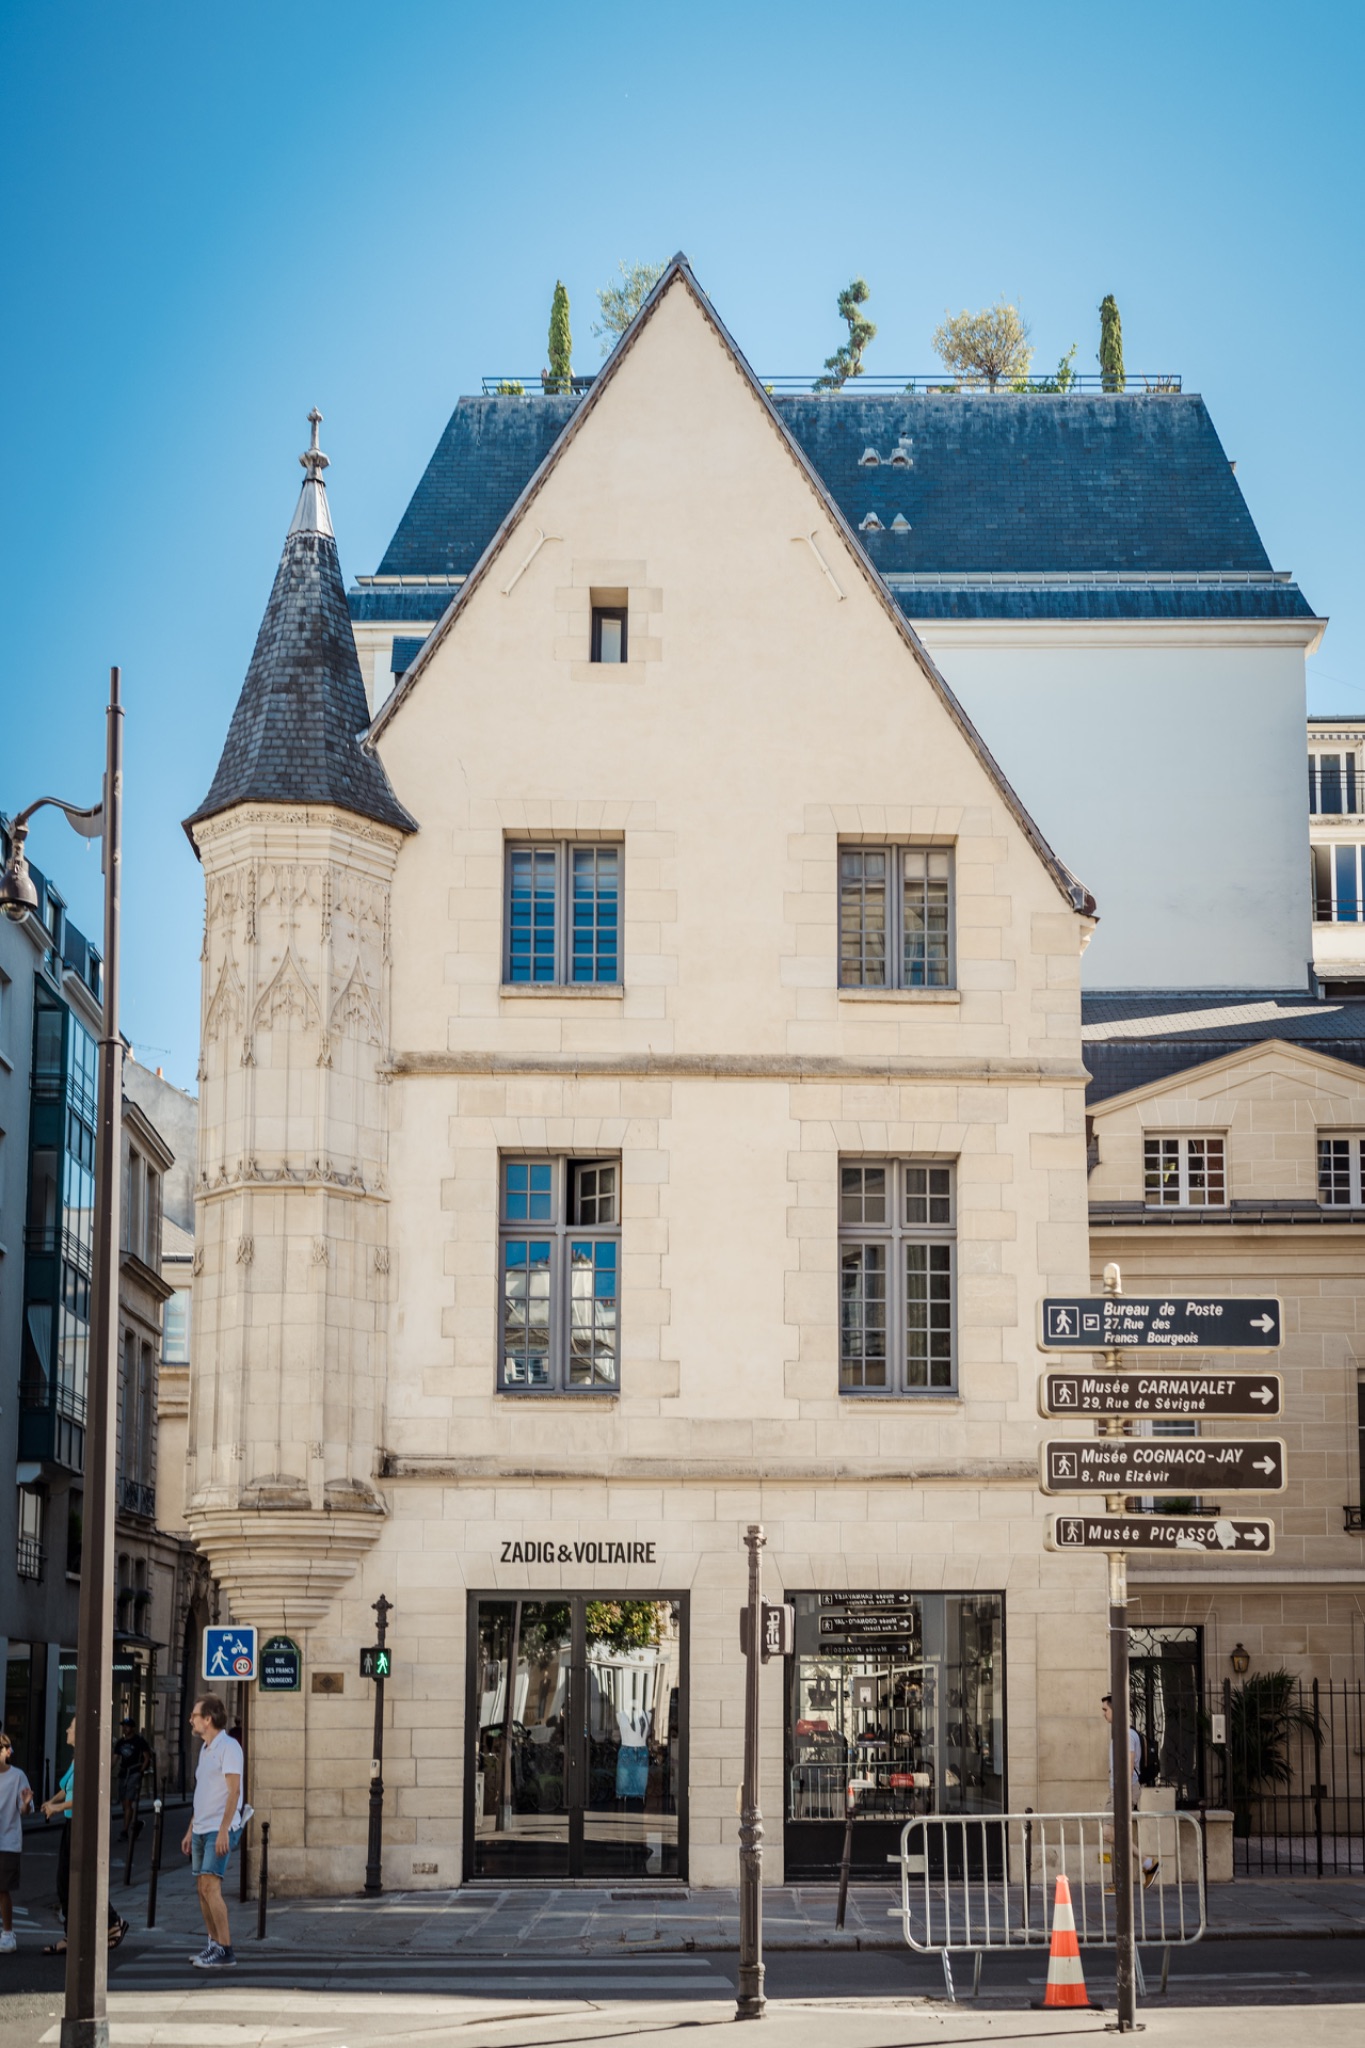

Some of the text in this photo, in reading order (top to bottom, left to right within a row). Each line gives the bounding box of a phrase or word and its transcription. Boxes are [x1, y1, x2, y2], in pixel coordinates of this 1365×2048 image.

[1103, 1301, 1224, 1316] Bureau de Poste
[1123, 1317, 1144, 1330] Rue
[1152, 1317, 1170, 1330] des
[1104, 1332, 1199, 1346] Francs Bourgeois
[1081, 1379, 1236, 1395] Musée CARNAVALET
[1105, 1397, 1130, 1409] Rue
[1134, 1397, 1150, 1409] de
[1155, 1397, 1206, 1411] Sévigné
[1081, 1449, 1128, 1464] Musée
[1097, 1470, 1121, 1482] Rue
[1126, 1470, 1170, 1482] Elzévir
[1088, 1525, 1217, 1542] Musée PICASSO
[237, 1662, 248, 1670] 20
